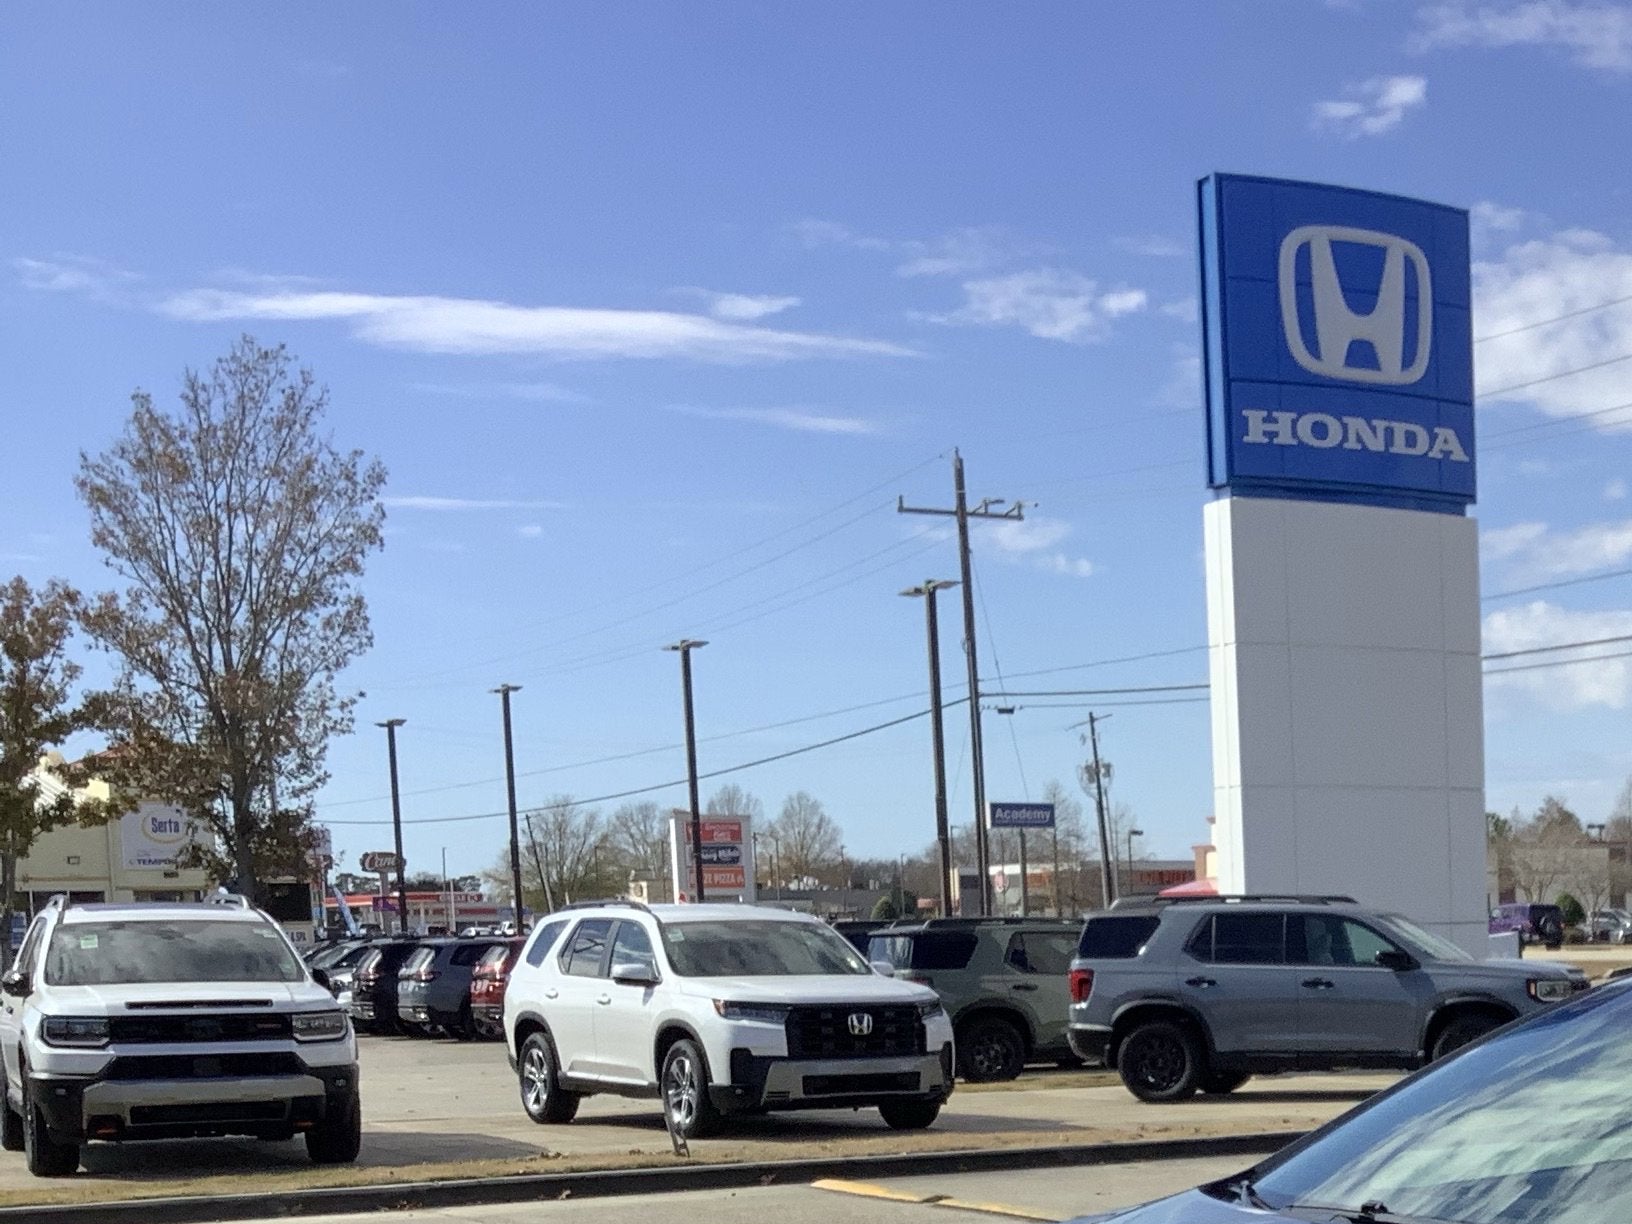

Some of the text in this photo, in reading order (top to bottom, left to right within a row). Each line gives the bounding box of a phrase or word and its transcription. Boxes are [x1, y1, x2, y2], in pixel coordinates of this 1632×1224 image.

[1242, 409, 1470, 463] HONDA
[995, 807, 1051, 823] Academy
[151, 817, 180, 833] Serta
